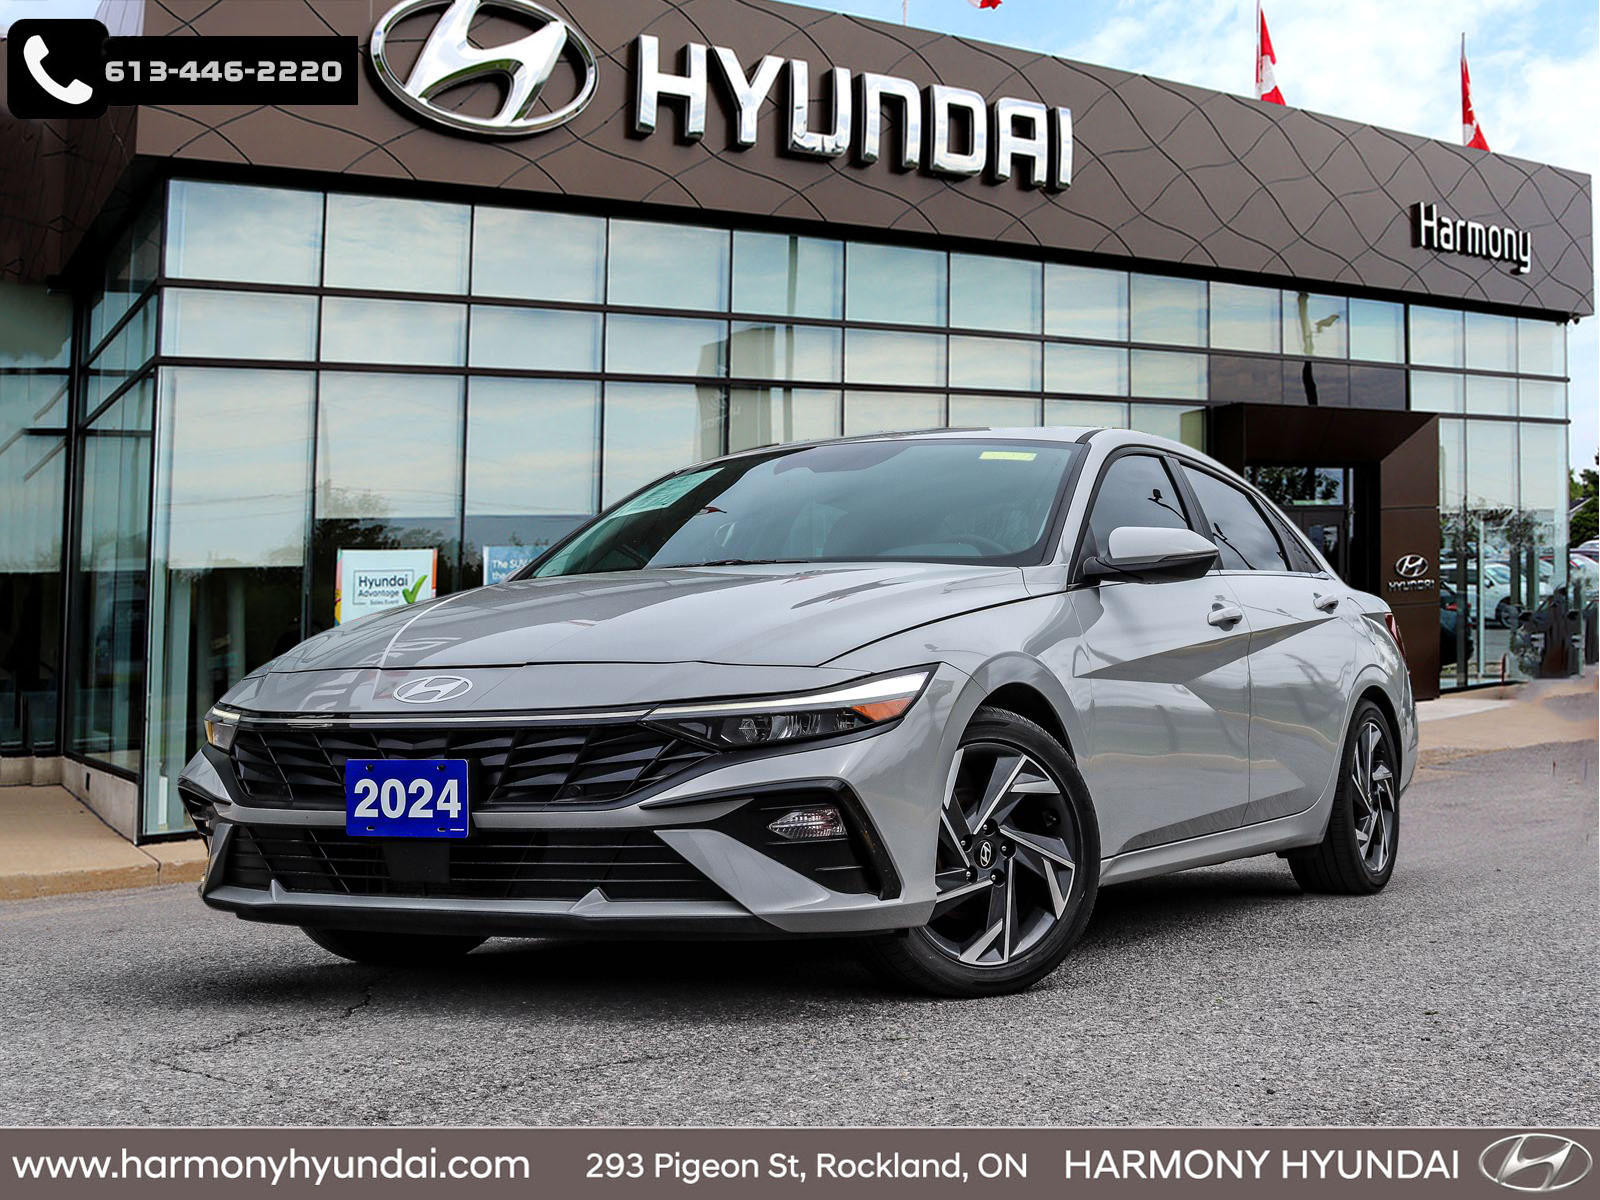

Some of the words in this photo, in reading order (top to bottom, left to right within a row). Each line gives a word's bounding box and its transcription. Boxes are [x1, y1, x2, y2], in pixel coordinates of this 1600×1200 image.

[635, 33, 1075, 191] HYUNDAI
[1417, 201, 1532, 274] Harmony
[358, 574, 409, 589] Hyundai
[358, 589, 400, 598] Advantage
[1387, 578, 1436, 592] HYUNDAI
[353, 778, 462, 819] 2024
